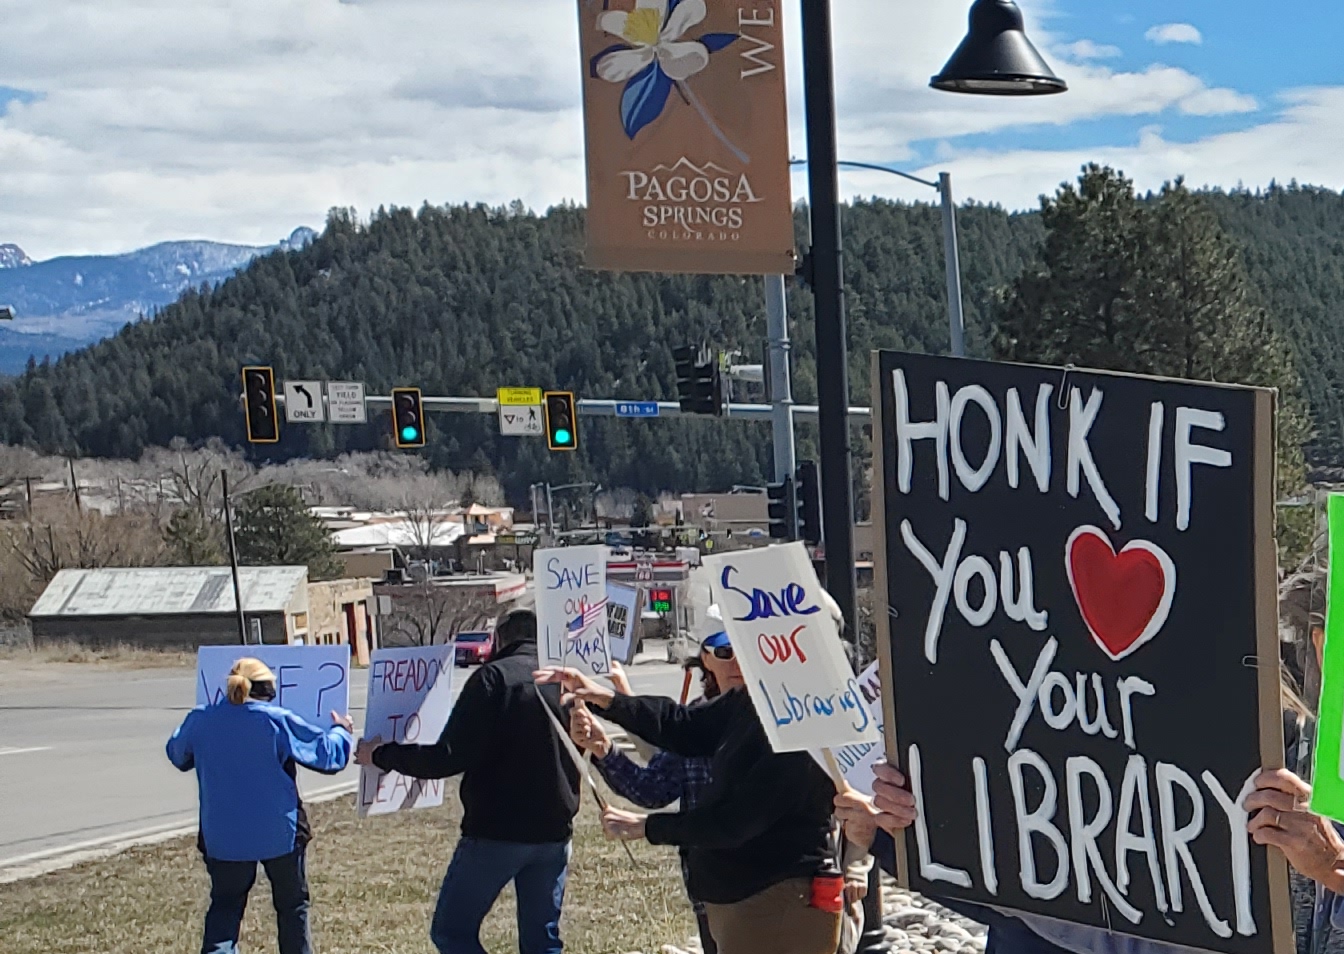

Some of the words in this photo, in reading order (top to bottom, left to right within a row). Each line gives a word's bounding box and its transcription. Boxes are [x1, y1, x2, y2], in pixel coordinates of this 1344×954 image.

[618, 171, 764, 203] PAGOSA
[643, 205, 743, 233] SPRINGS
[647, 230, 740, 241] COLORADO
[293, 410, 316, 419] ONLY
[892, 368, 1122, 530] HONK
[1145, 401, 1232, 531] IF
[546, 557, 600, 591] SAVE
[721, 565, 822, 622] Save
[387, 712, 421, 743] TO
[908, 743, 1263, 939] LIBRARY
